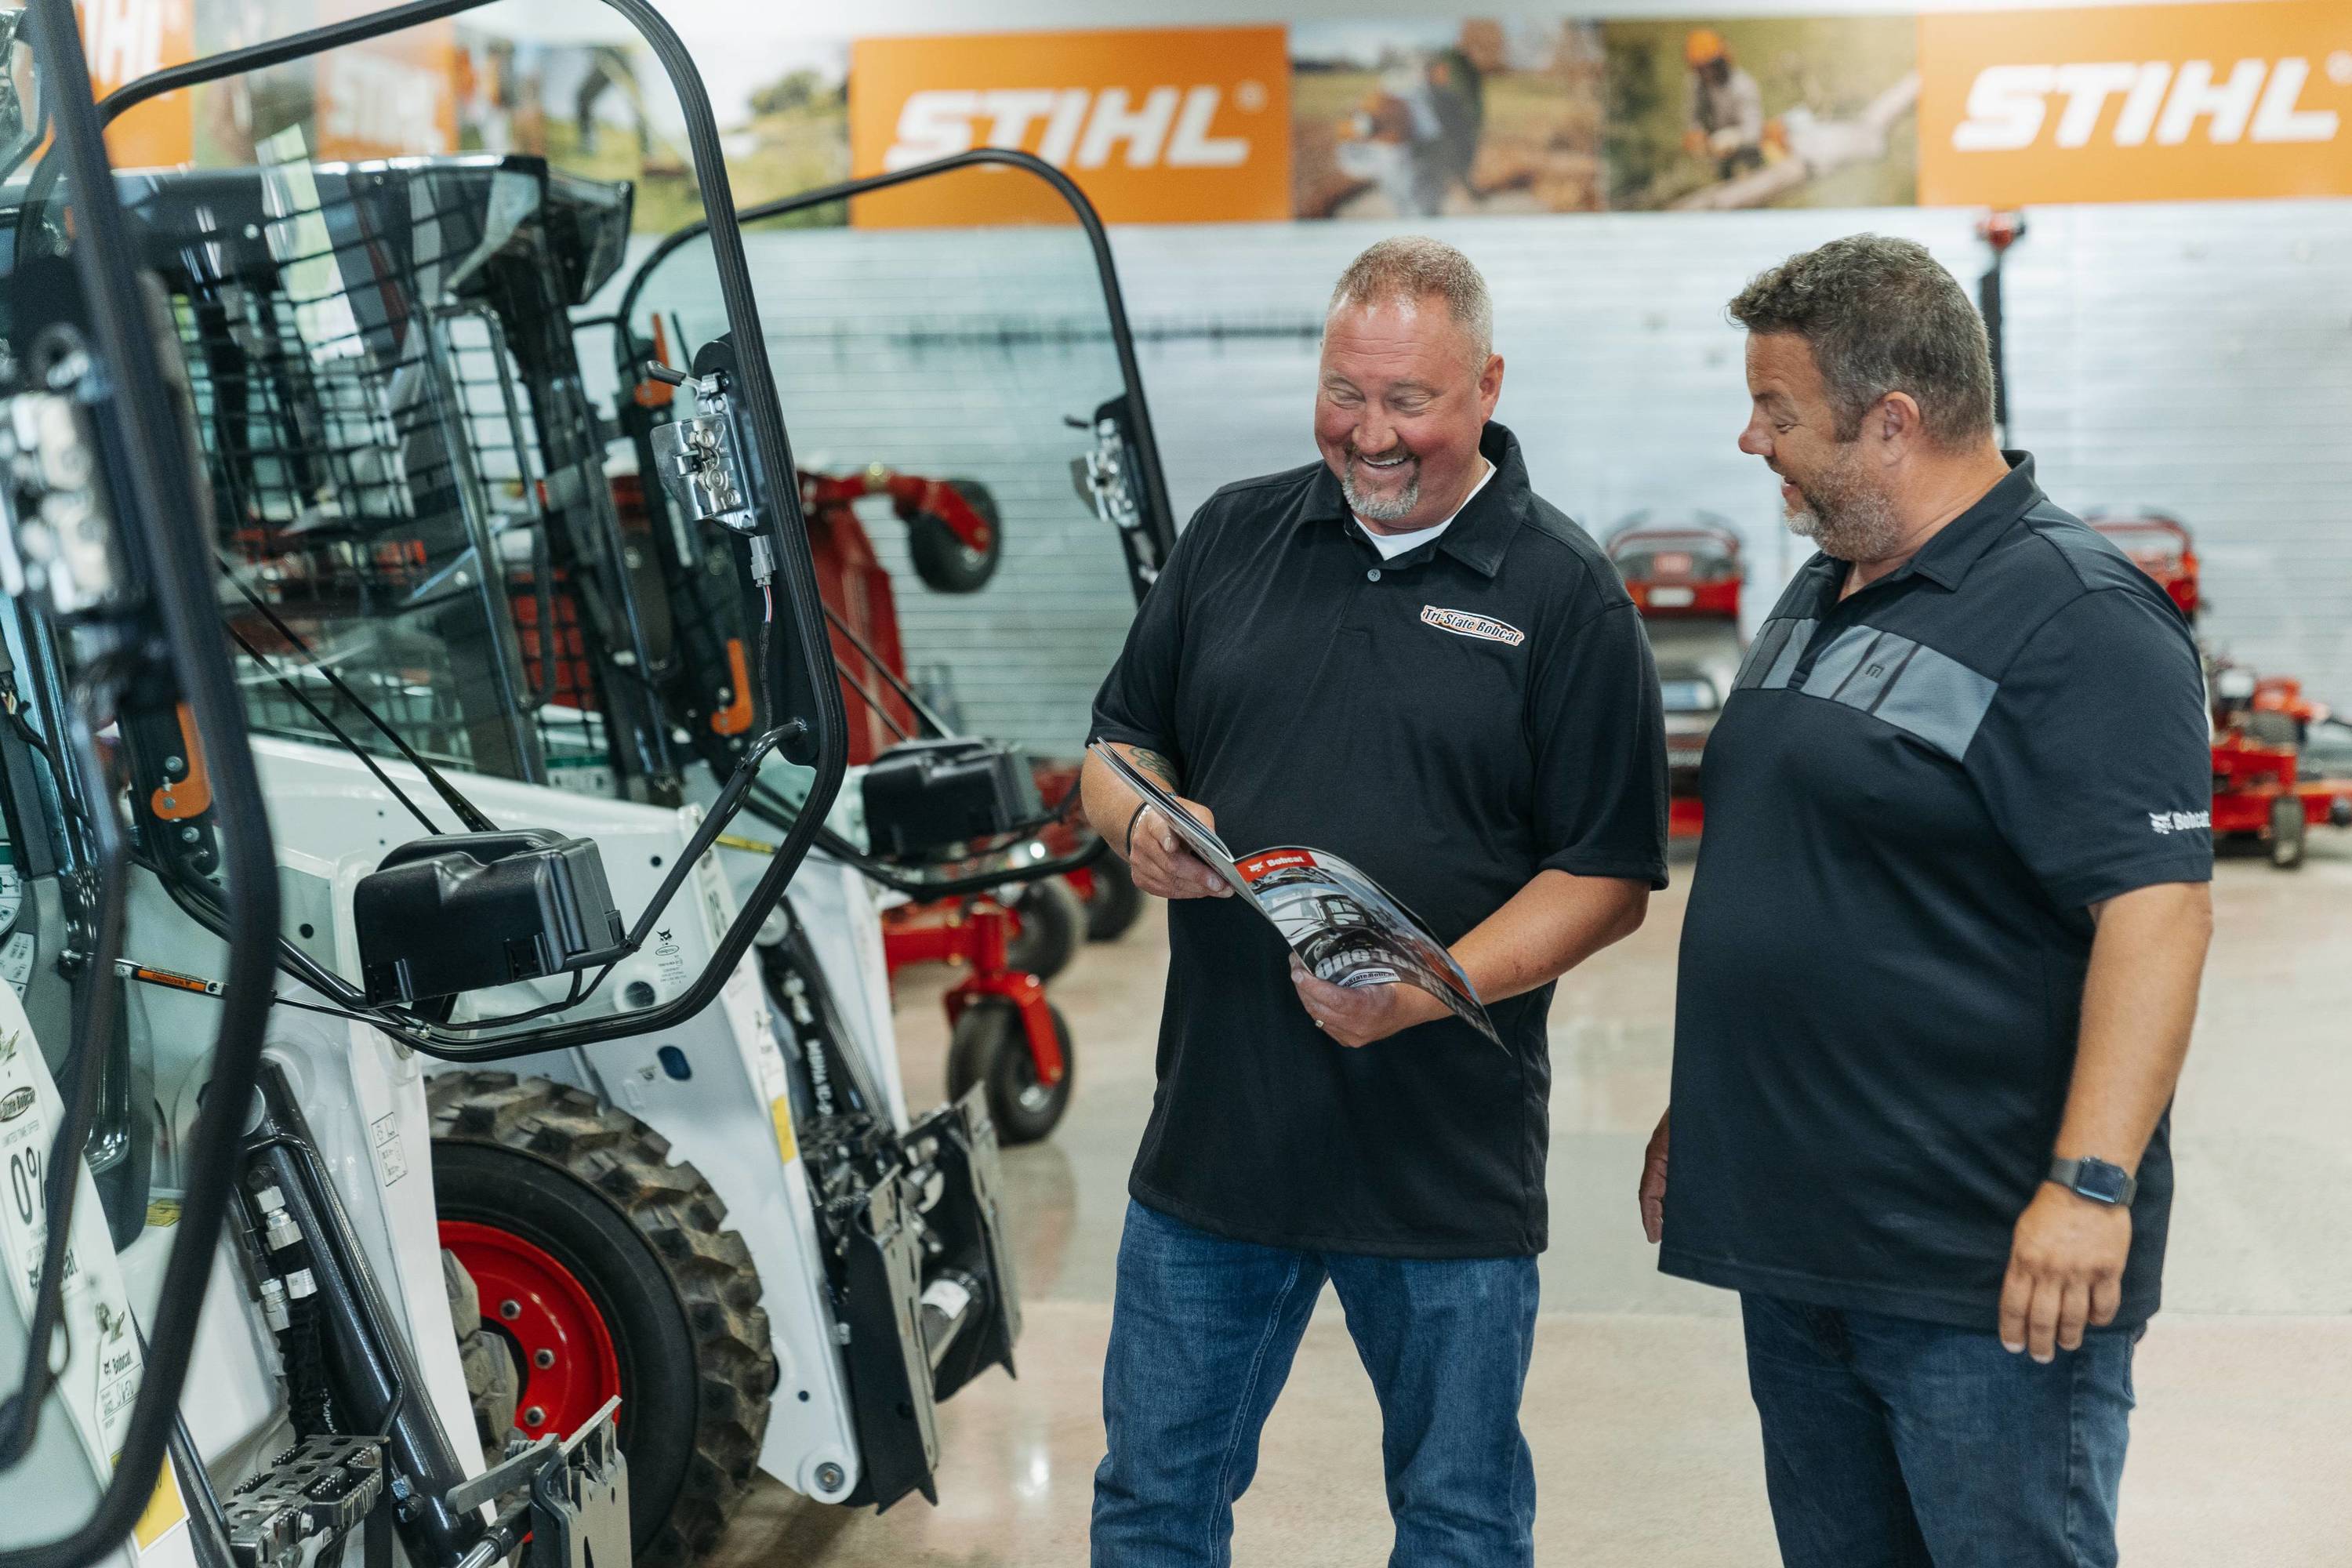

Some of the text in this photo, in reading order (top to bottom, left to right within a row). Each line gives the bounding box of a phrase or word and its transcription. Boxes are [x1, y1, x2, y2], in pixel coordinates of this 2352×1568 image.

[1951, 56, 2340, 151] STIHL
[884, 86, 1250, 170] STIHL
[1424, 608, 1520, 644] Tri-State Bobcat
[1266, 856, 1305, 866] Bobcat
[1315, 948, 1370, 980] One
